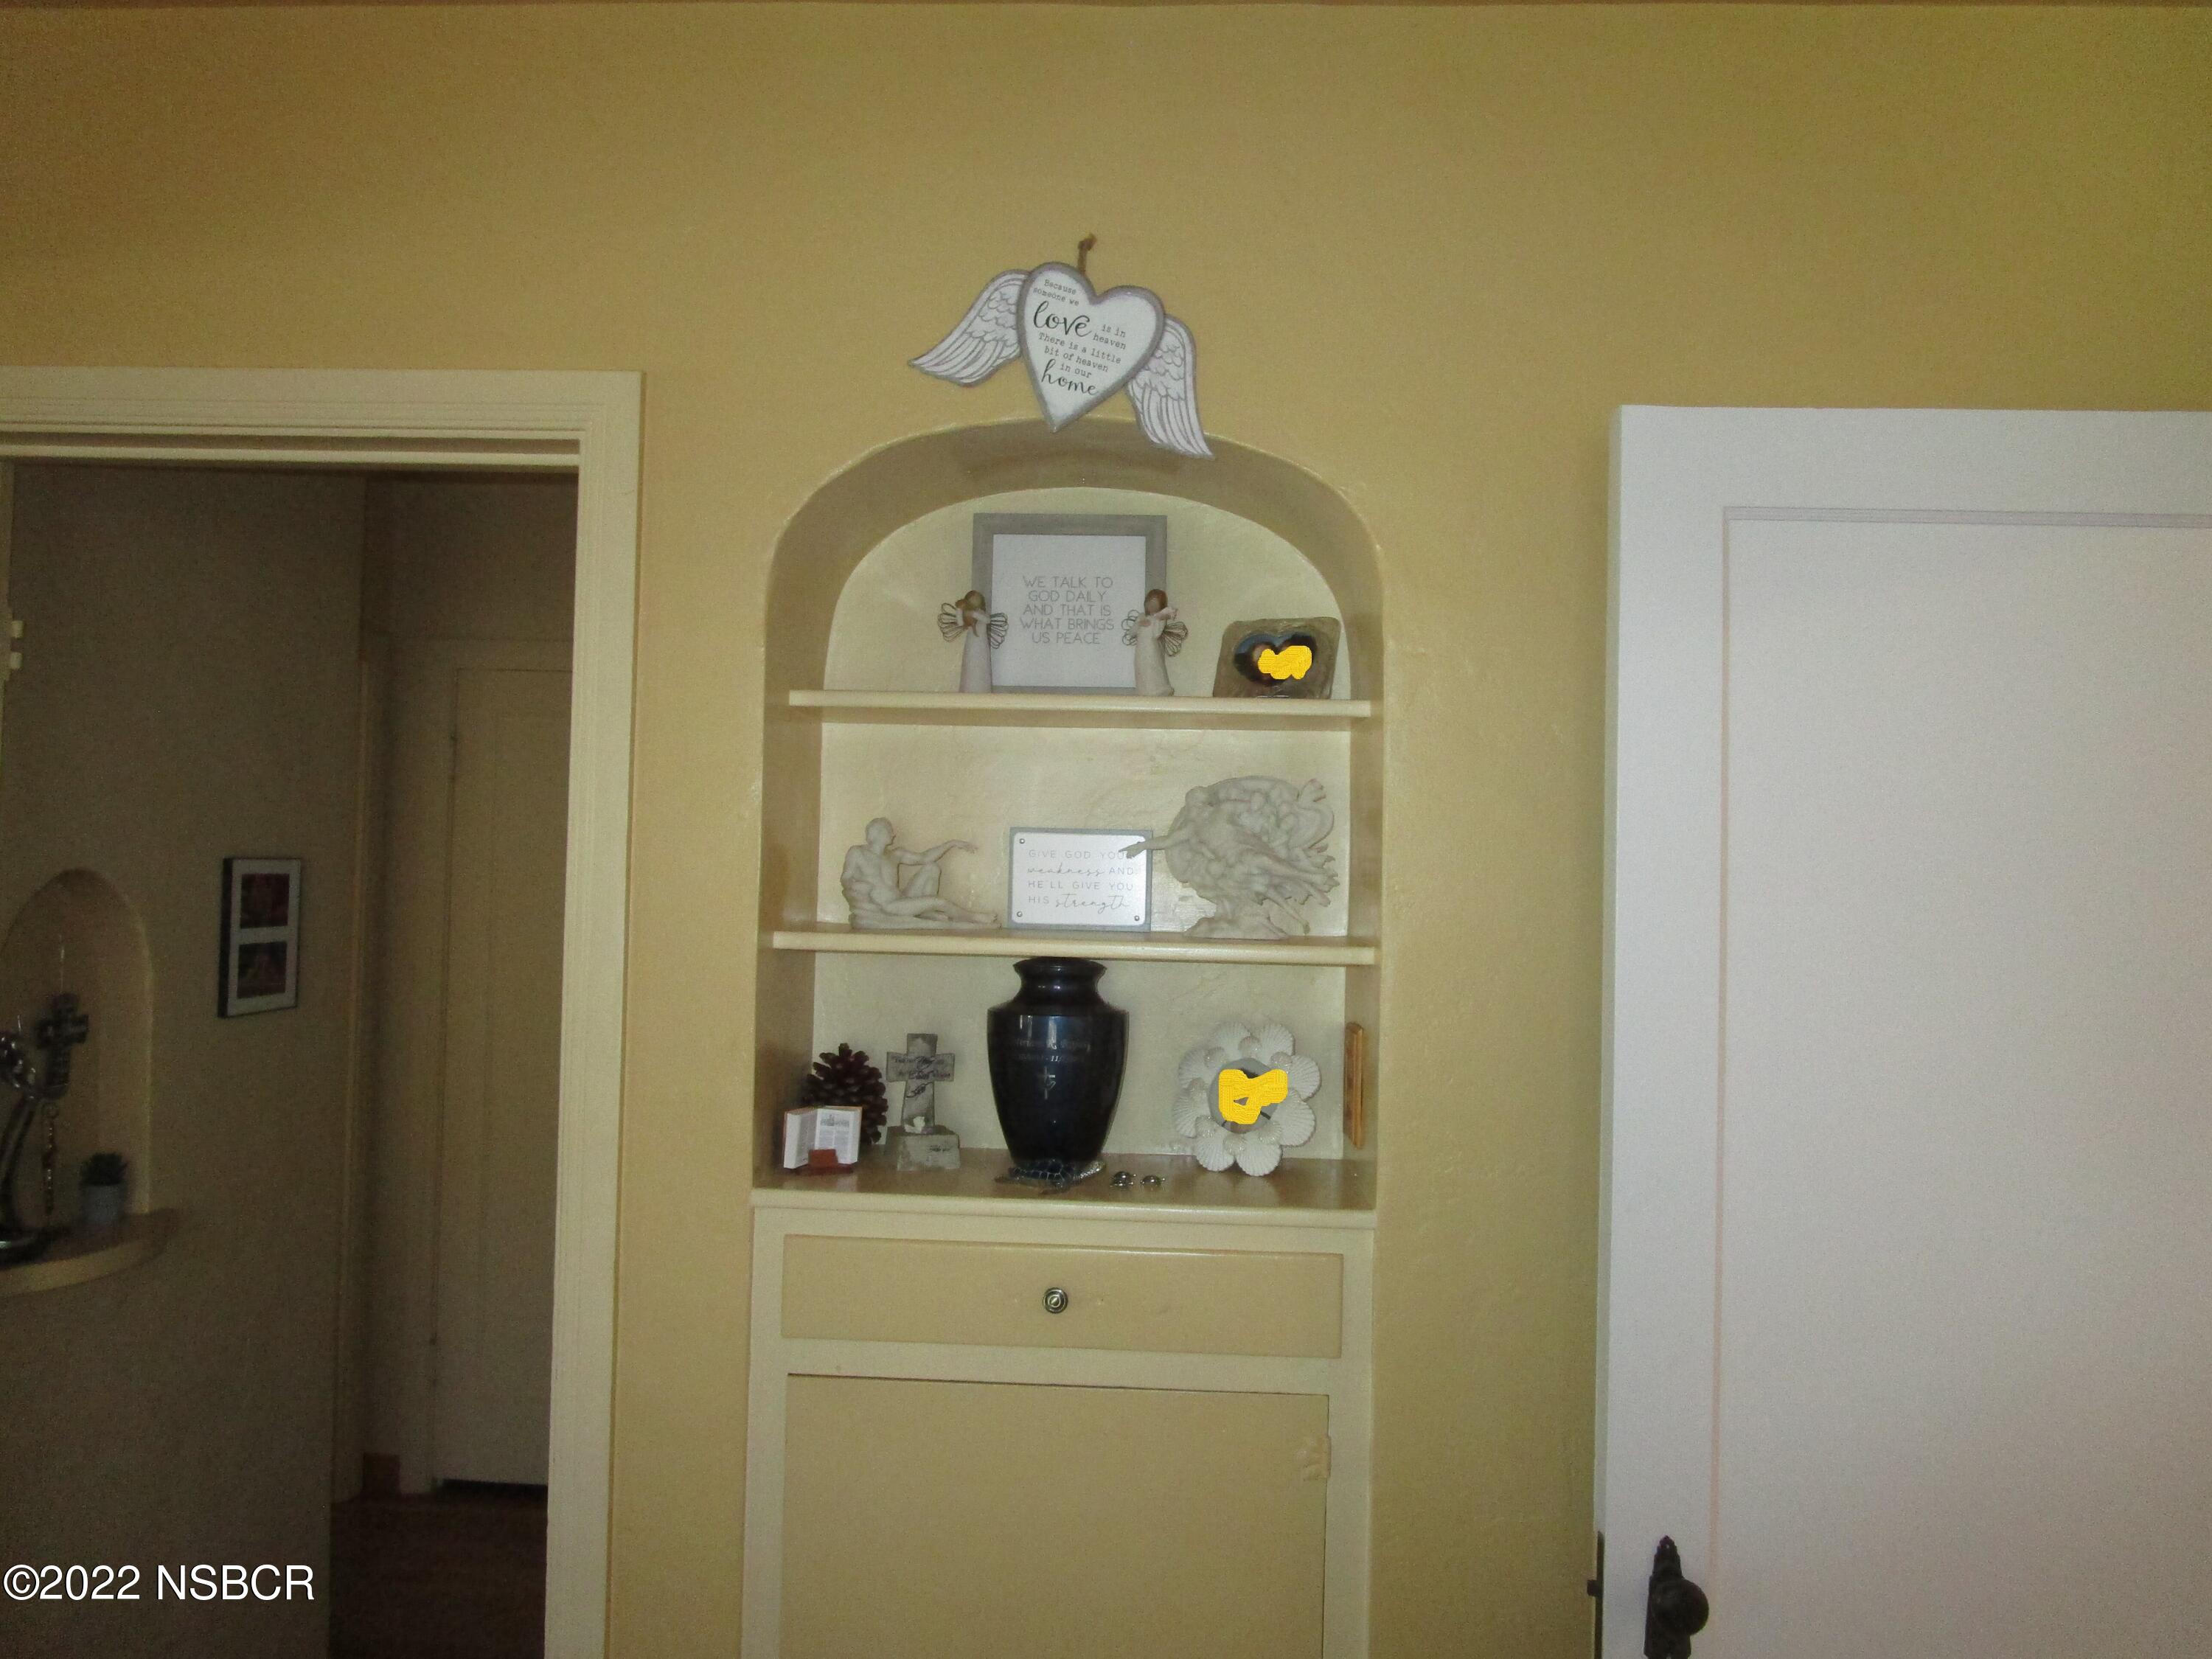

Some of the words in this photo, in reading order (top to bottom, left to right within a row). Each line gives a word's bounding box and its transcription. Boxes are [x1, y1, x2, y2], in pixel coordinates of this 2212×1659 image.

[1044, 279, 1077, 294] Because
[1033, 288, 1065, 302] someone
[1034, 301, 1092, 337] love
[1102, 324, 1111, 333] is
[1115, 327, 1126, 337] in
[1093, 333, 1126, 349] heaven
[1038, 333, 1065, 346] There
[1068, 342, 1078, 350] is
[1091, 348, 1121, 364] little
[1045, 346, 1059, 356] bit
[1076, 356, 1109, 372] heaven
[1042, 358, 1099, 395] home
[1060, 364, 1071, 372] in
[1075, 368, 1092, 378] our
[1023, 576, 1045, 588] WE
[1052, 577, 1086, 588] TALK
[1095, 577, 1113, 588] TO
[1029, 591, 1060, 602] GOD
[1066, 591, 1107, 602] DAILY
[1023, 605, 1053, 616] AND
[1061, 605, 1096, 616] THAT
[1101, 605, 1111, 616] IS
[1020, 618, 1062, 629] WHAT
[1068, 619, 1114, 630] BRINGS
[1032, 633, 1050, 644] US
[1057, 633, 1101, 644] PEACE
[1029, 849, 1056, 858] GIVE
[1065, 850, 1091, 859] GOD
[1100, 851, 1125, 860] YOU
[1028, 863, 1105, 876] weakness
[1109, 867, 1134, 875] AND
[1073, 881, 1100, 890] GIVE
[1109, 882, 1133, 891] YOU
[1029, 896, 1050, 904] HIS
[1055, 894, 1130, 914] strength
